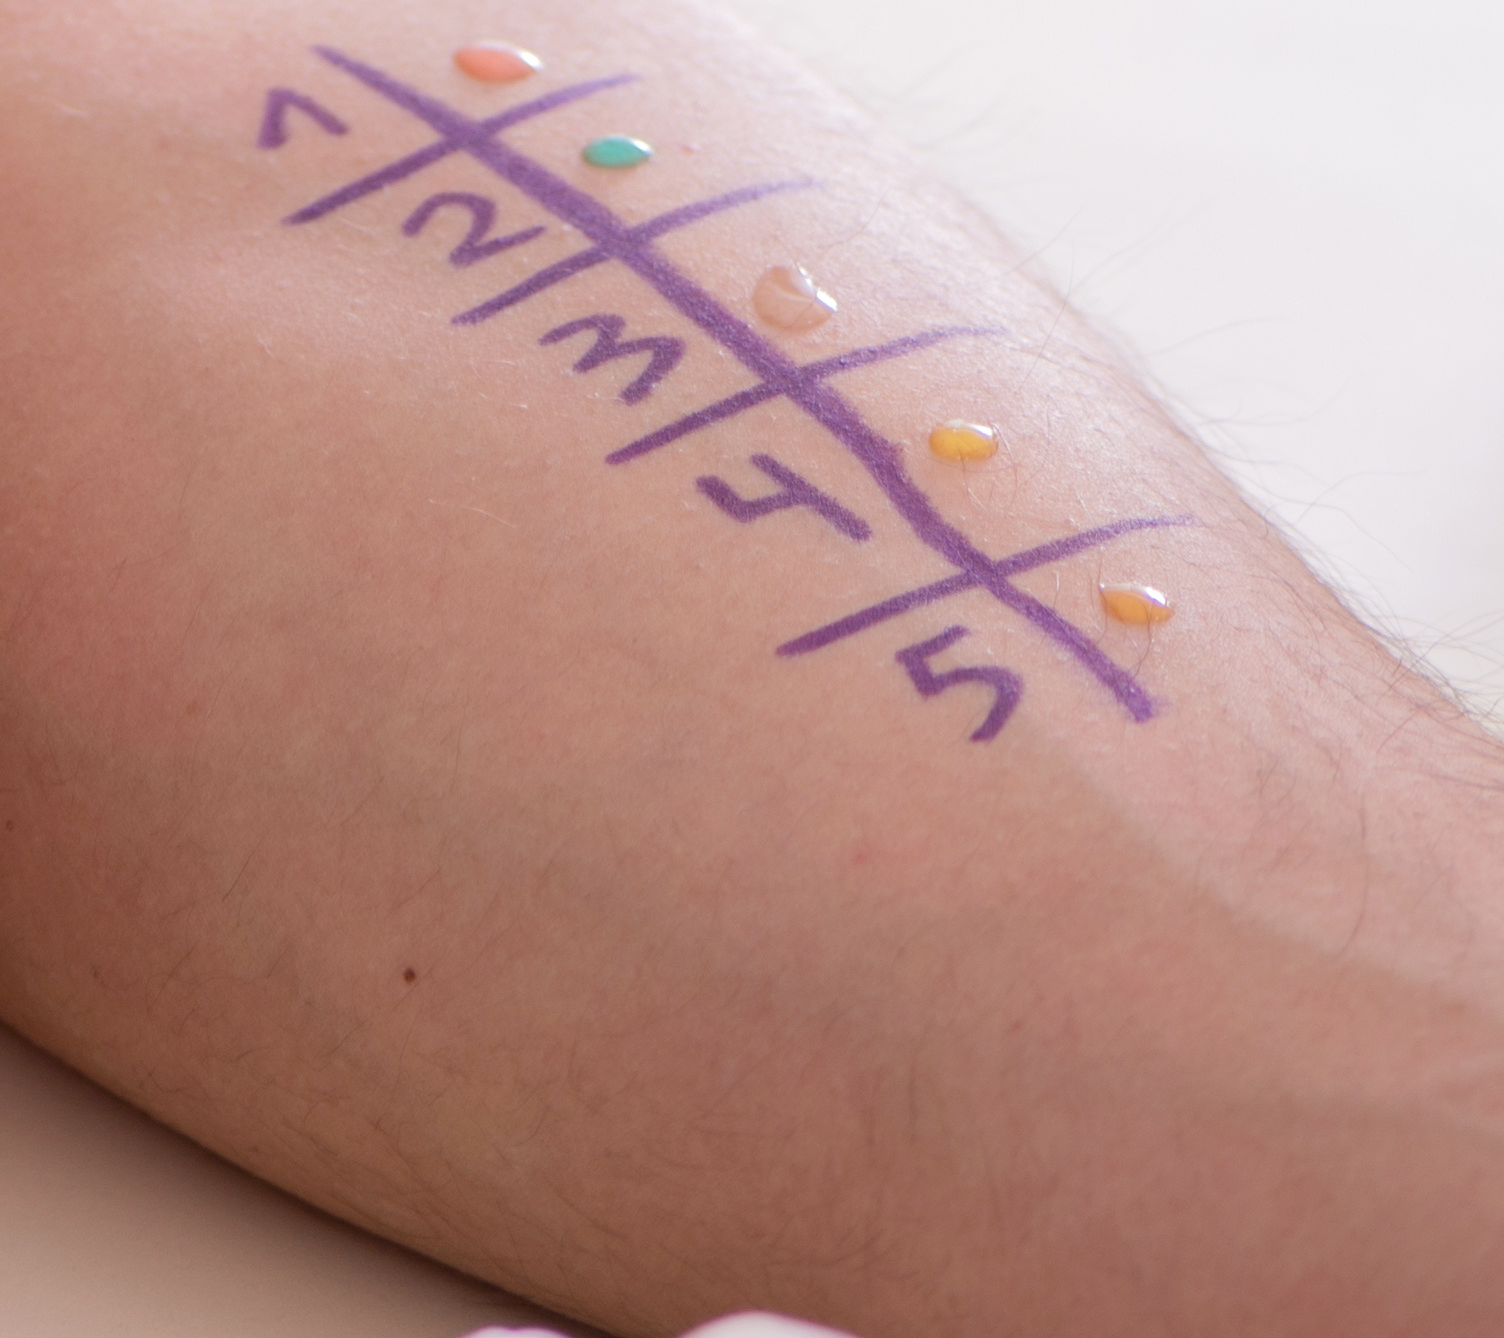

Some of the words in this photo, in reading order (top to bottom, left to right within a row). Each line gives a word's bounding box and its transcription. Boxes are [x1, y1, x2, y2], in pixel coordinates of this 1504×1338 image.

[258, 89, 348, 149] 1
[402, 191, 546, 267] 2
[538, 315, 686, 405] 3
[696, 454, 872, 541] 4
[895, 625, 1022, 741] 5
